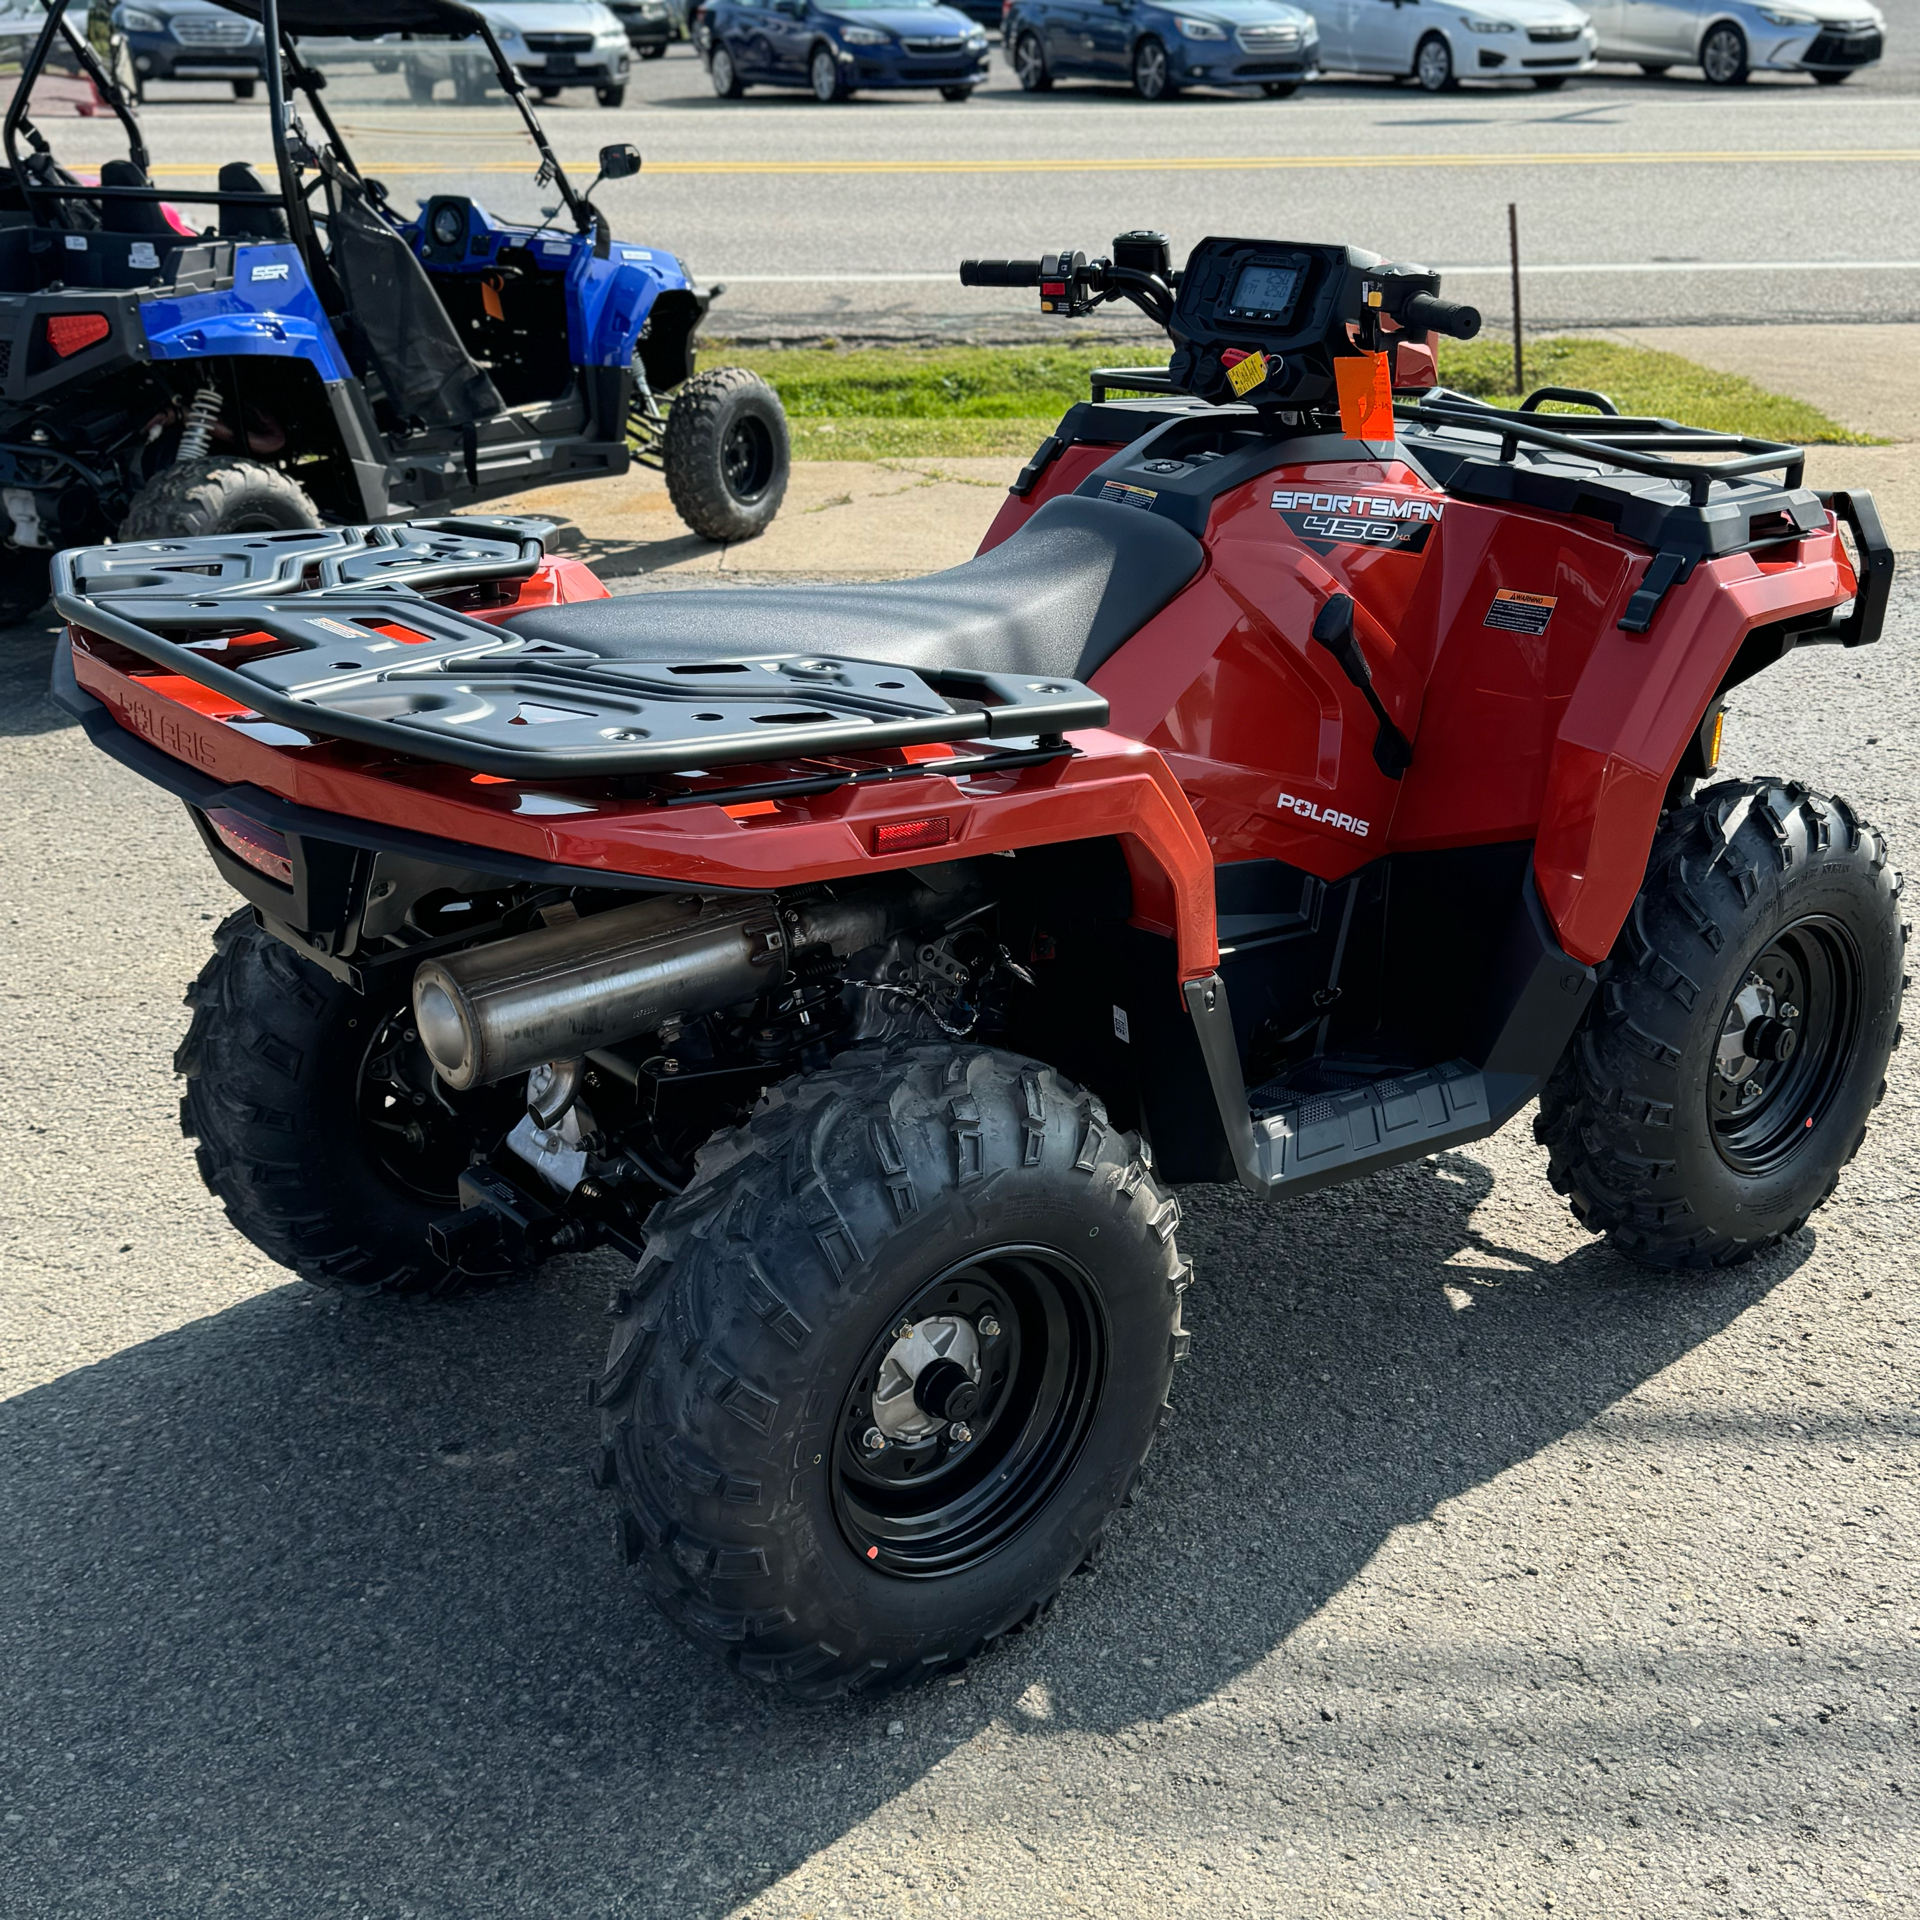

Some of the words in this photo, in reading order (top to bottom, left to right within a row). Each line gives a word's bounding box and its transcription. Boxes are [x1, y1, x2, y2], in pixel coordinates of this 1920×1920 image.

[251, 264, 289, 281] SSR
[1270, 491, 1444, 522] SPORTSMAN
[1303, 515, 1398, 542] 450
[1516, 593, 1544, 604] WARNING
[1276, 792, 1370, 837] POLARIS
